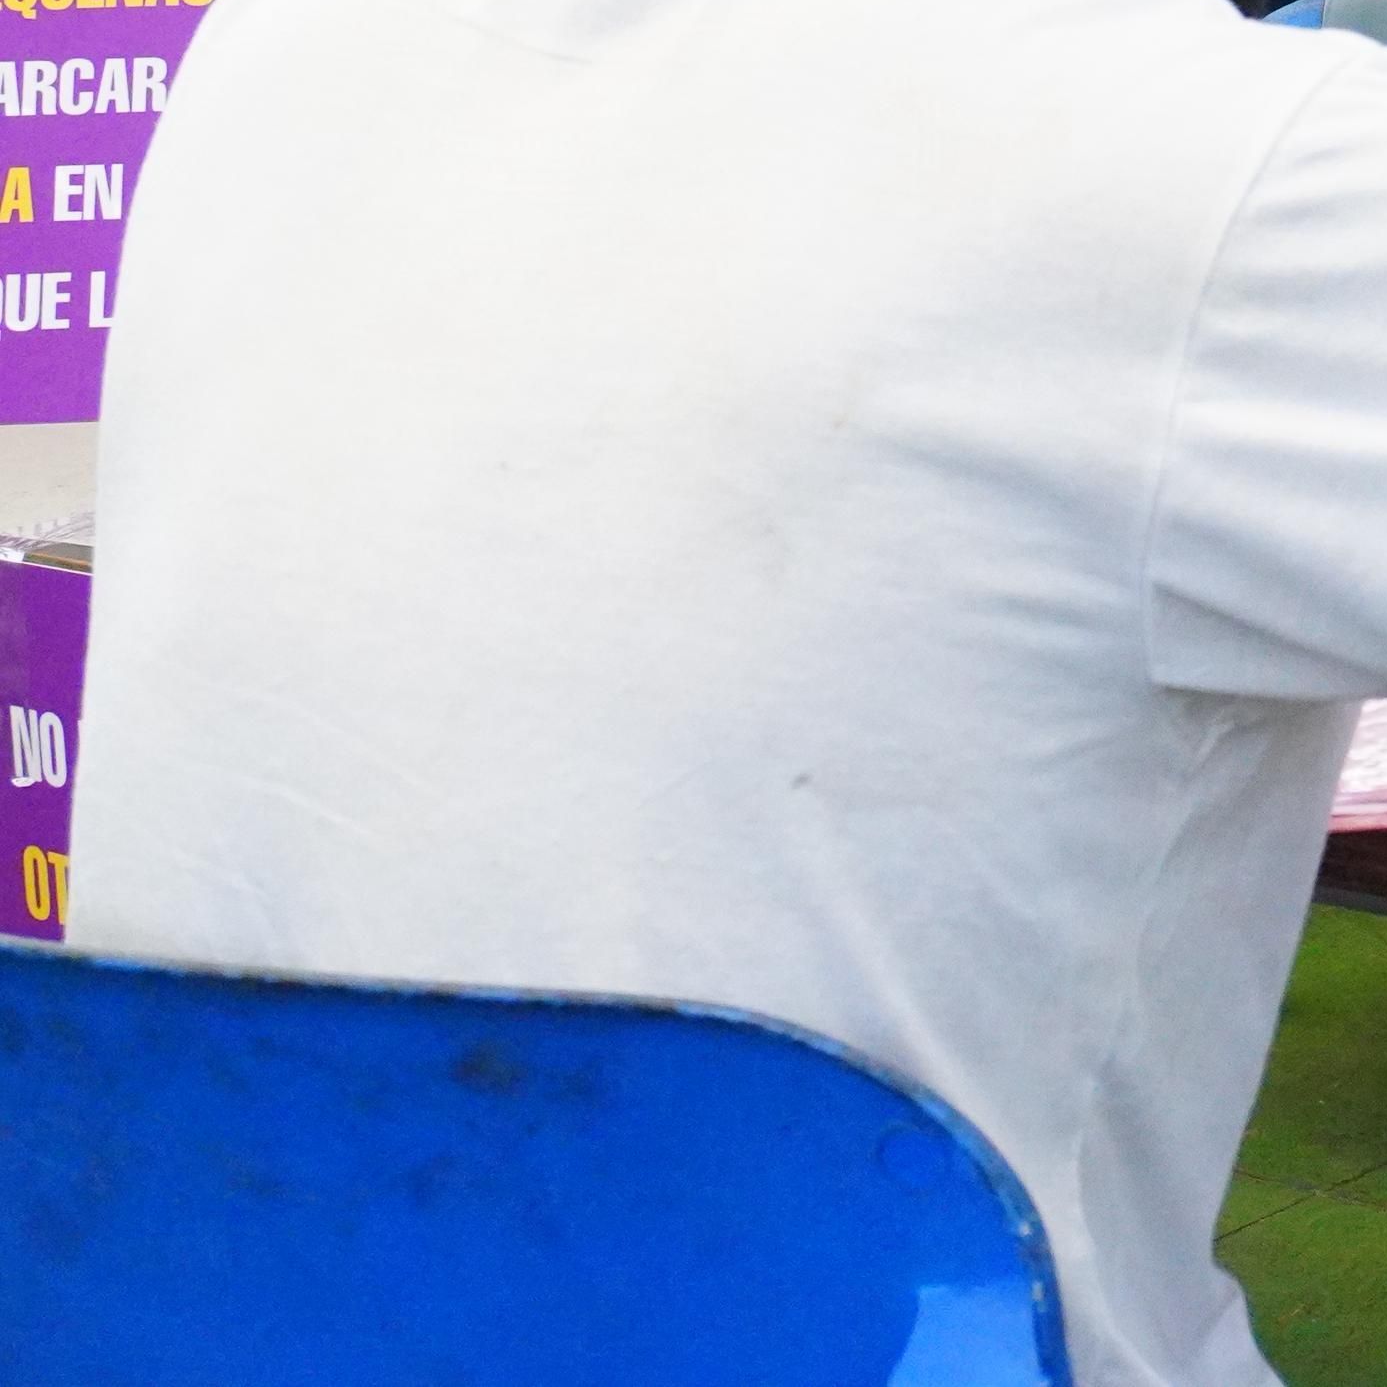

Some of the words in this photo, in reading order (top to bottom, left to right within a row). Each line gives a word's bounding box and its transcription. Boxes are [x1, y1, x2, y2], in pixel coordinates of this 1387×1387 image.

[54, 163, 123, 221] EN
[0, 272, 72, 340] UE
[10, 706, 67, 789] NO
